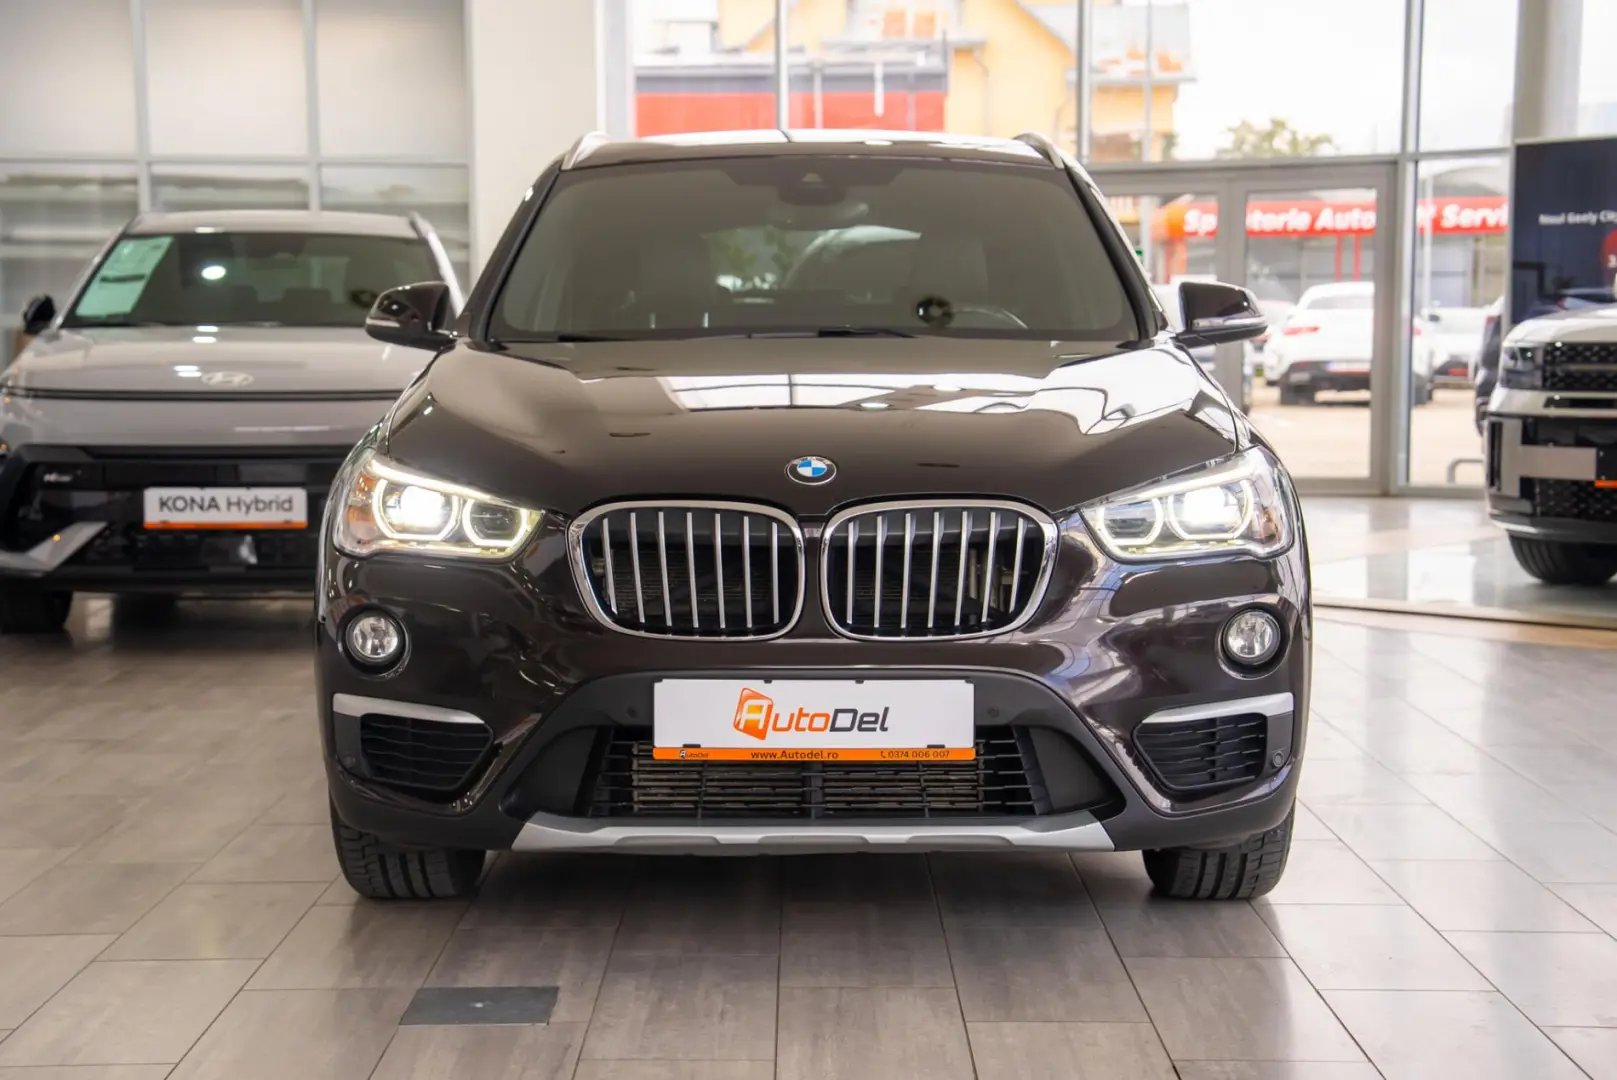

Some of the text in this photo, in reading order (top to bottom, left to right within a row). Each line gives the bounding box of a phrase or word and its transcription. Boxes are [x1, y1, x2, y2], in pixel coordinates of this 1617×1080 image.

[1313, 206, 1377, 232] Auto
[158, 494, 294, 515] KONA Hybrid
[736, 693, 890, 735] AutoDel
[750, 749, 839, 760] www.Autodel.ro
[888, 749, 950, 759] 0374 006 007
